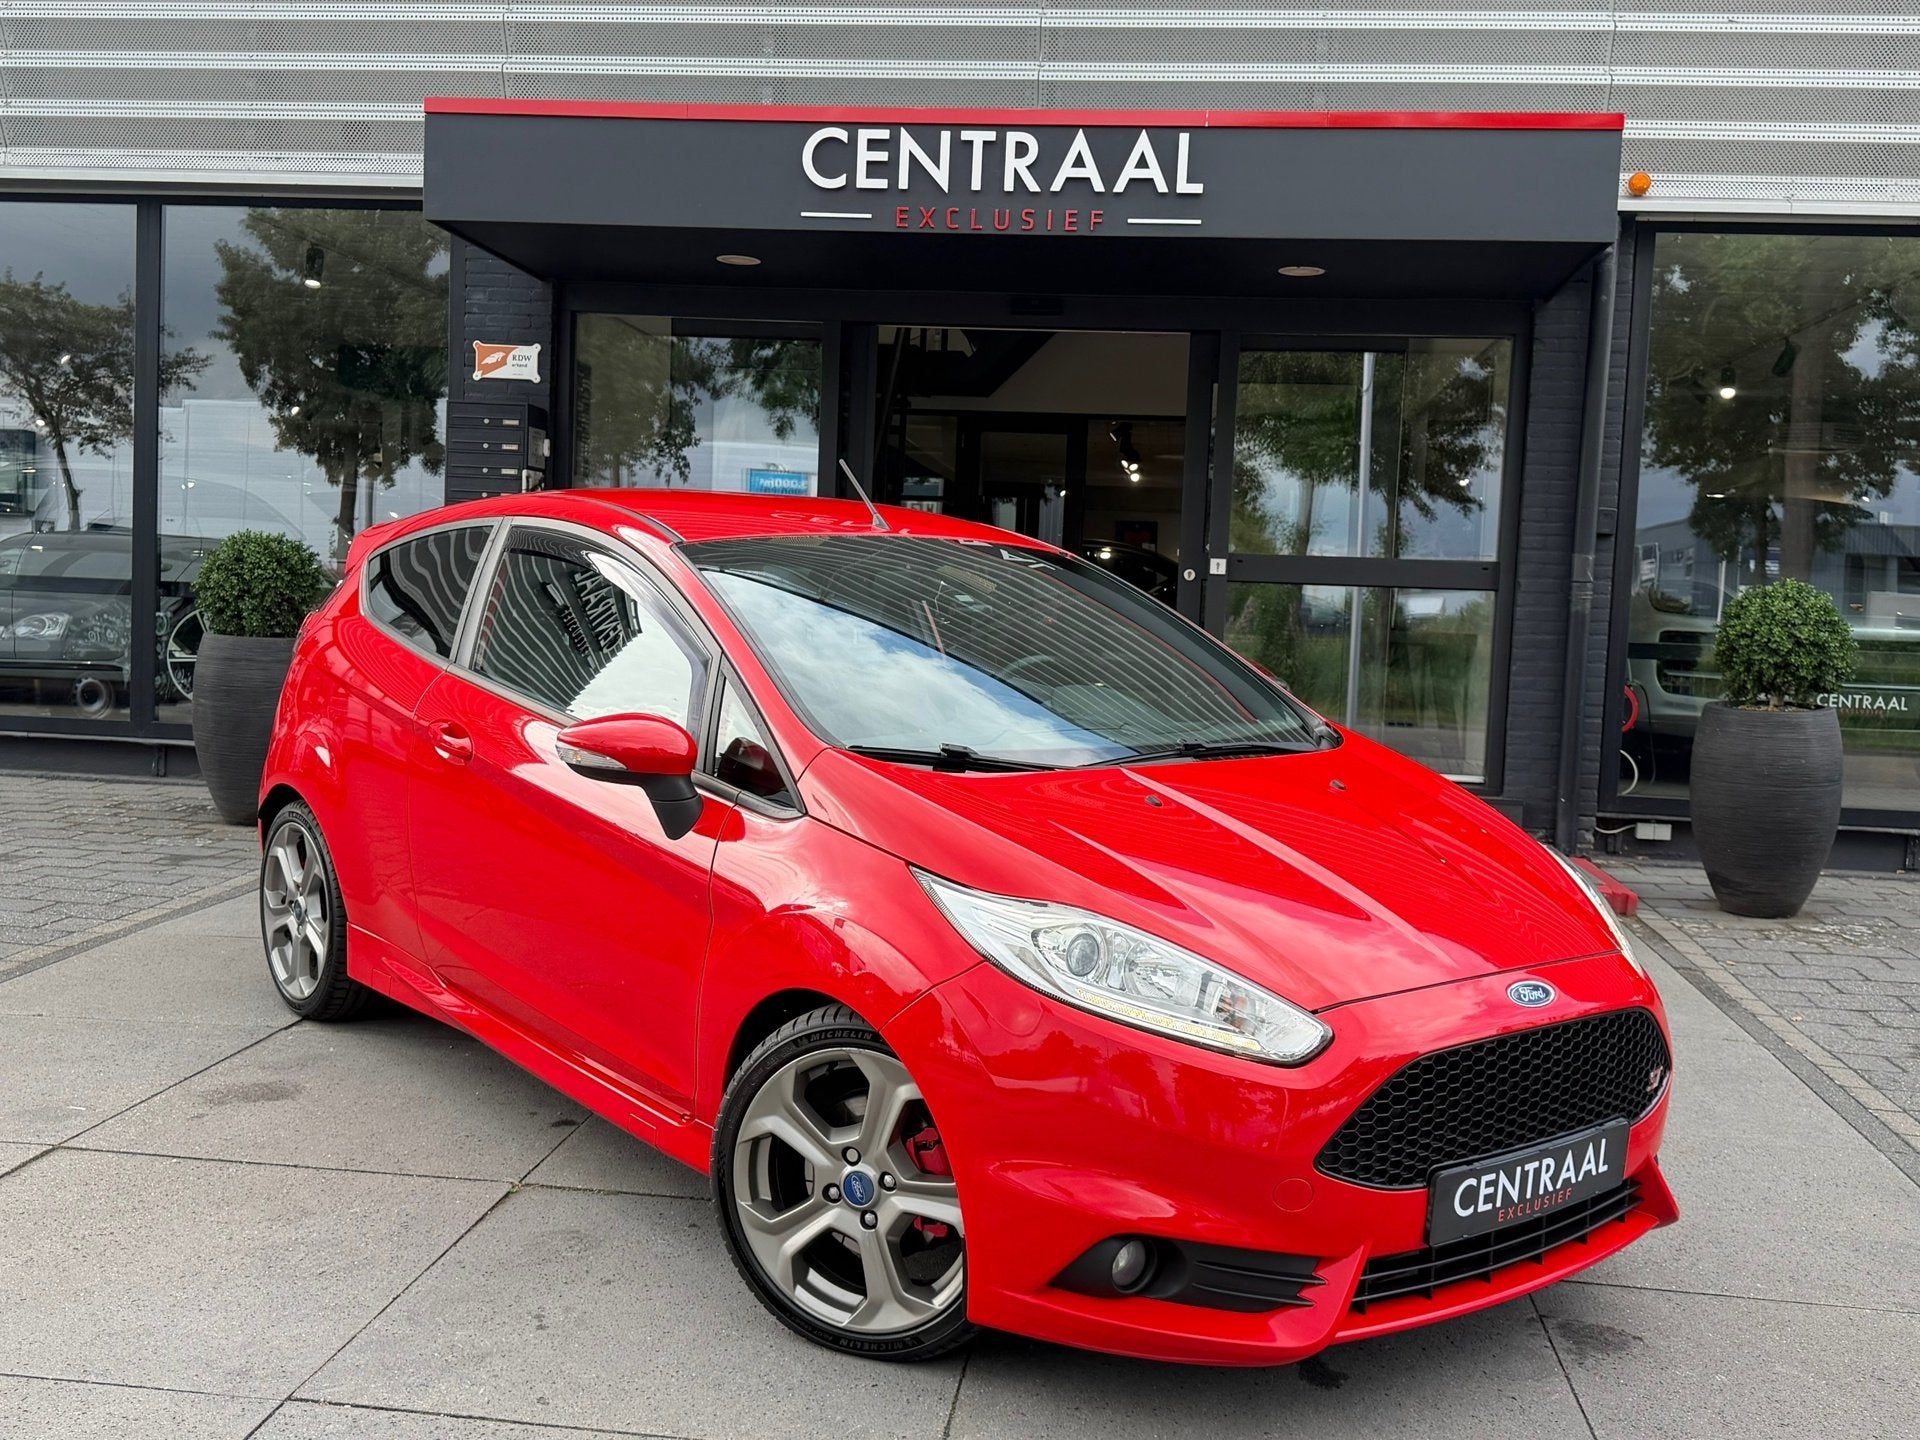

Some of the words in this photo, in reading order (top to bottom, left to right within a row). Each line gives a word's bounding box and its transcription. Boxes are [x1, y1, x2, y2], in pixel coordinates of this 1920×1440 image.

[801, 126, 1204, 194] CENTRAAL
[895, 206, 1104, 231] EXCLUSIEF
[512, 354, 532, 362] RDW
[1816, 693, 1908, 711] CENTRAAL
[1518, 985, 1546, 1002] Ford
[810, 1030, 873, 1042] MICHELIN
[1453, 1138, 1609, 1218] CENTRAAL
[1497, 1187, 1573, 1223] EXCLUSIEF
[839, 1337, 904, 1350] MICHELIN
